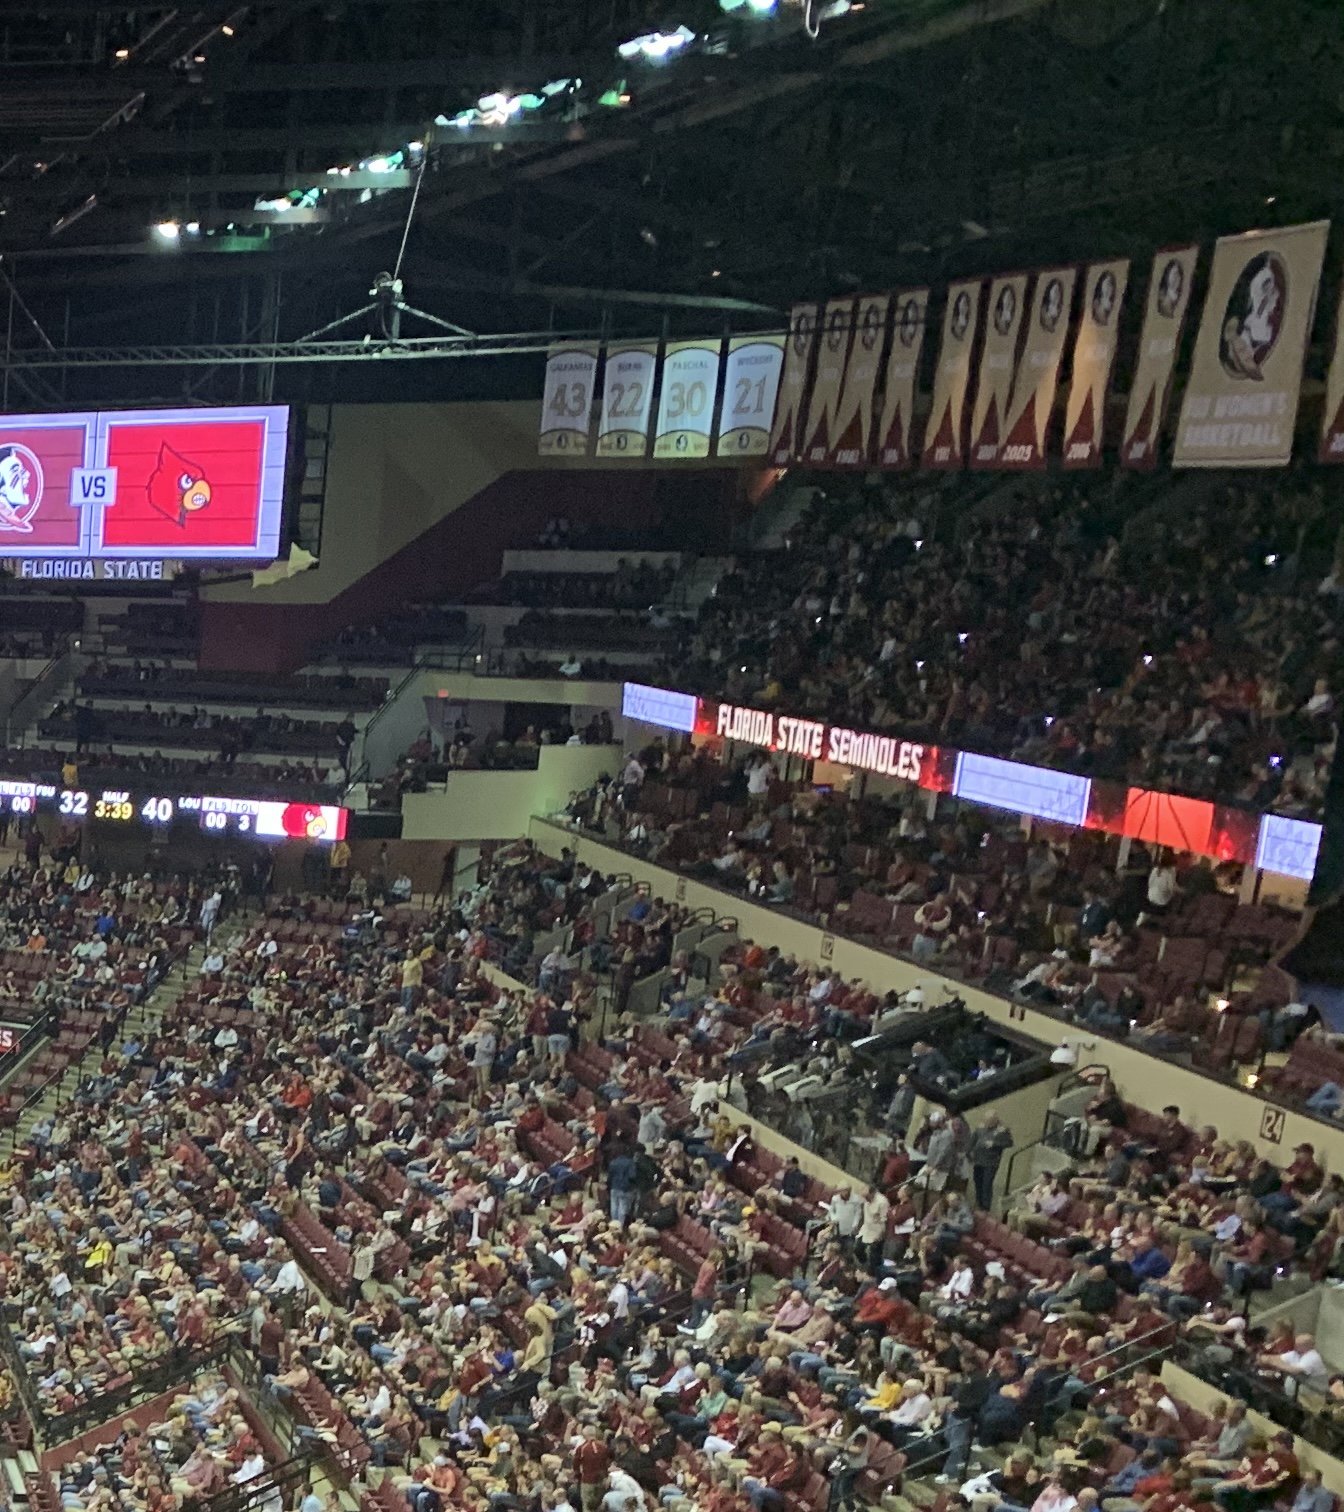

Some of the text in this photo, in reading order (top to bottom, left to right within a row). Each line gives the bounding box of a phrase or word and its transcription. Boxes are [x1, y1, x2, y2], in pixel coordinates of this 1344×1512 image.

[550, 382, 587, 418] 43
[608, 382, 644, 418] 22
[667, 380, 707, 418] 30
[732, 374, 768, 415] 21
[81, 475, 106, 498] VS
[21, 559, 164, 579] FLORIDA STATE
[717, 702, 923, 781] FLORIDA STATE SEMINOLES
[60, 791, 88, 815] 32
[95, 801, 132, 820] 3:39
[142, 798, 172, 822] 40
[179, 797, 200, 810] LOU
